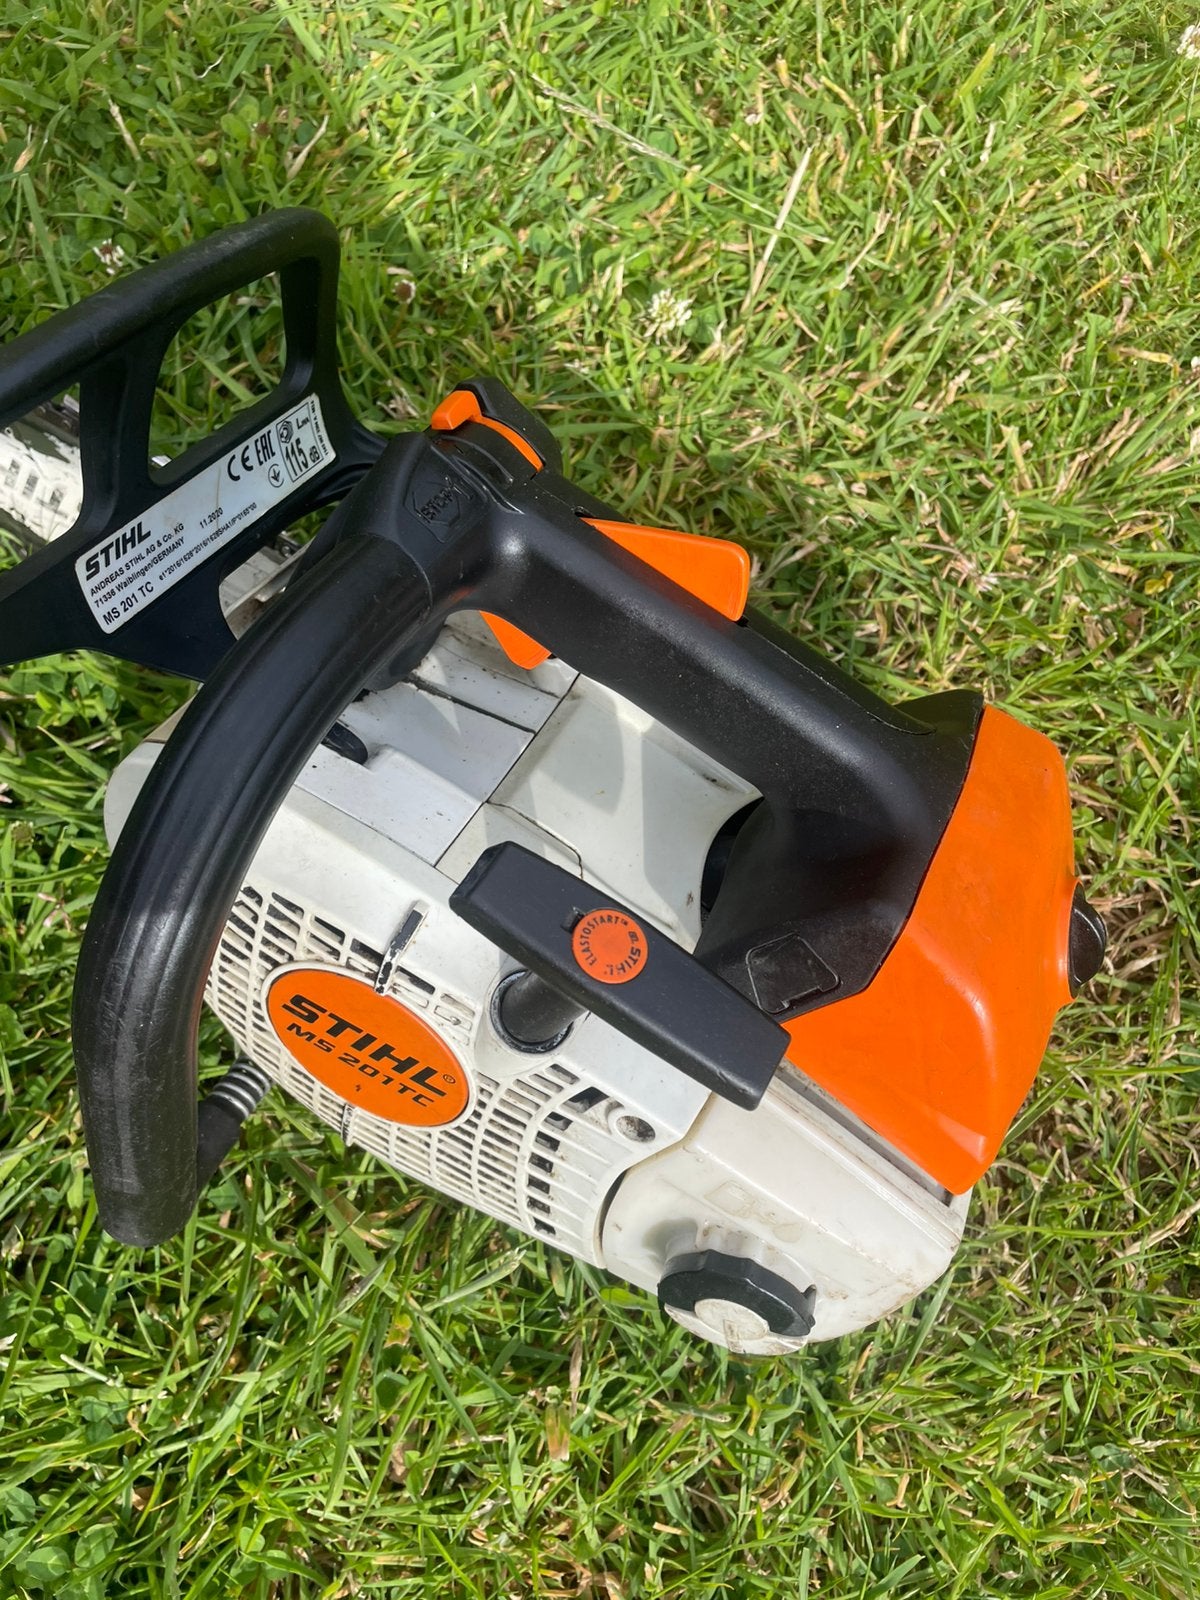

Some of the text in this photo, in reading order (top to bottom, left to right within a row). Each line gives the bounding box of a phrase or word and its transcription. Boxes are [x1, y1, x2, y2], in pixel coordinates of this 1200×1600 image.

[227, 445, 254, 481] CE
[285, 438, 320, 477] 115 dB
[199, 507, 223, 529] 11.2020
[85, 521, 151, 581] STIHL
[90, 565, 125, 597] ANDREAS
[125, 554, 146, 571] STIHL
[145, 544, 156, 556] AG
[156, 539, 163, 547] &
[173, 523, 184, 535] KG
[94, 537, 185, 608] 71336 Waiblingen/GERMANY
[102, 581, 154, 625] MS 201 TC
[286, 1022, 336, 1053] MS
